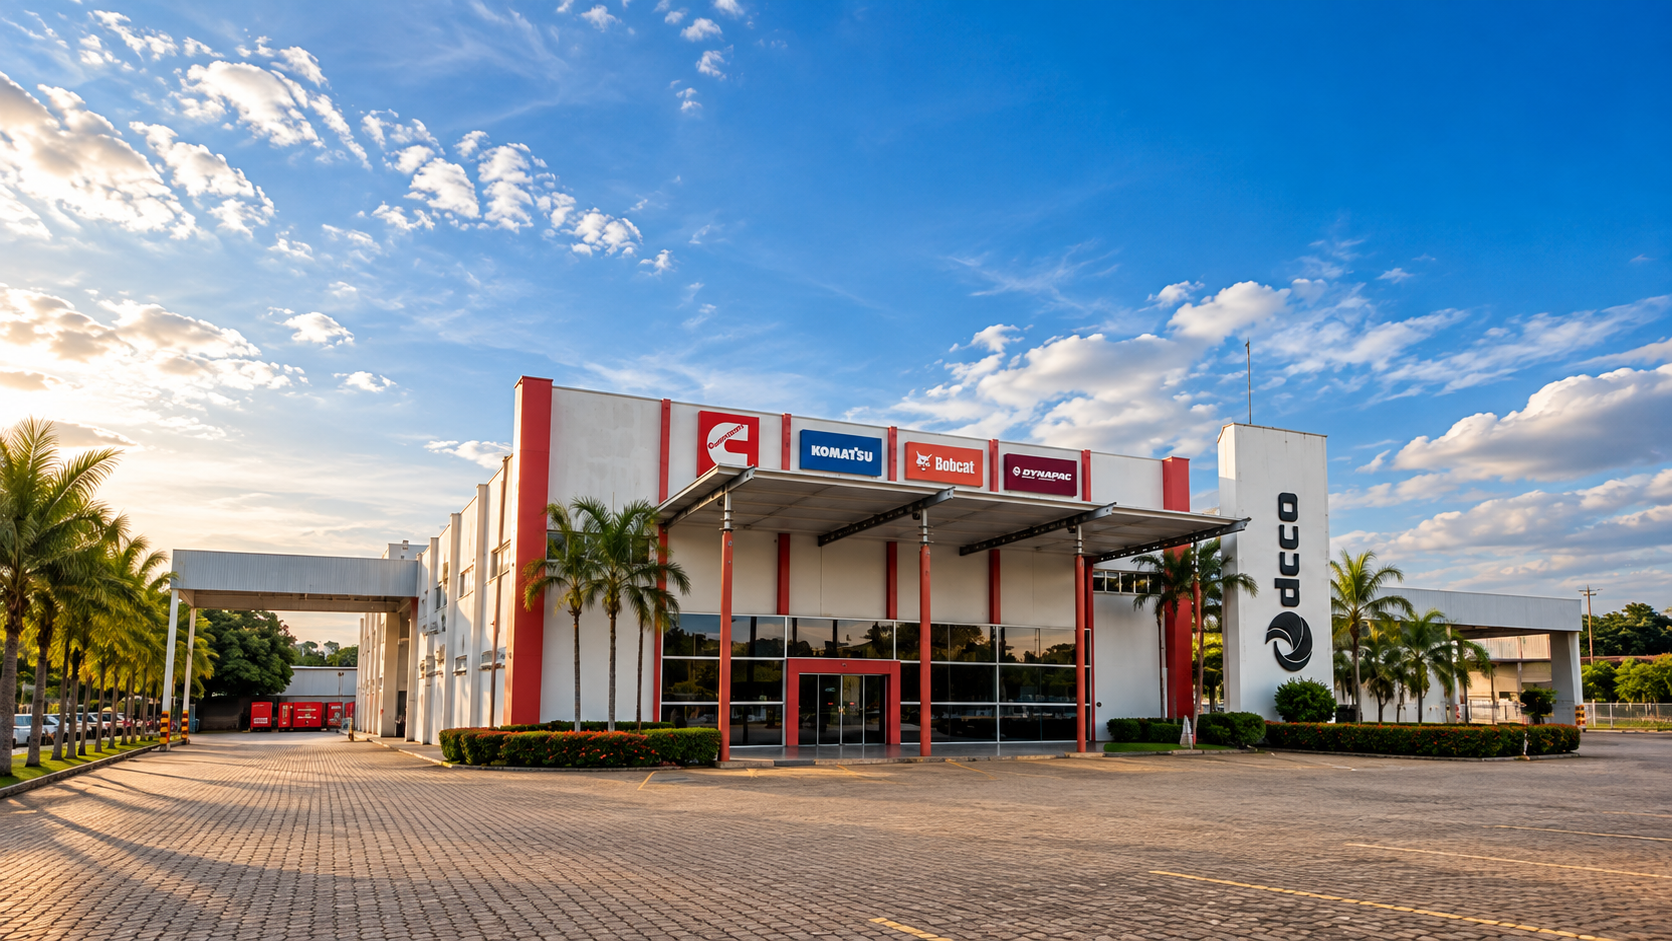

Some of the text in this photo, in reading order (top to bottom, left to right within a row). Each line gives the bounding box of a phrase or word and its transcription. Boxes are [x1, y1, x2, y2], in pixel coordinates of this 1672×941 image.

[811, 445, 873, 462] KOMATSU
[935, 456, 975, 474] Bobcat
[1022, 469, 1072, 481] DYNAPAC
